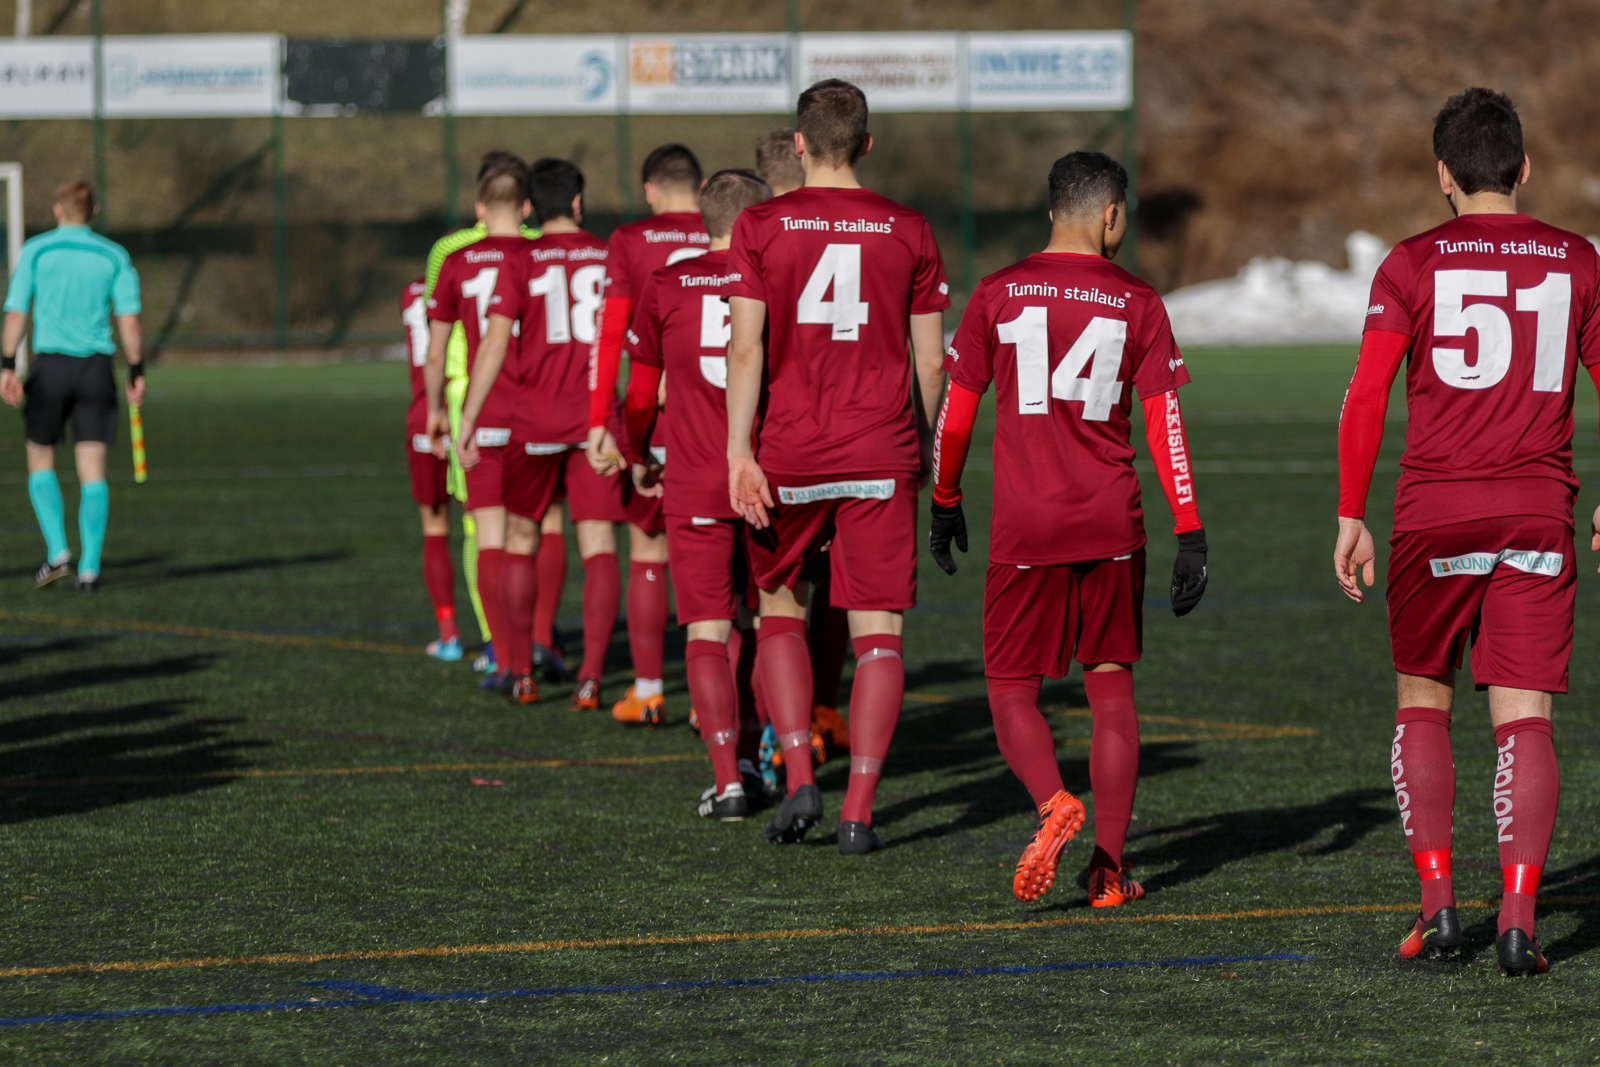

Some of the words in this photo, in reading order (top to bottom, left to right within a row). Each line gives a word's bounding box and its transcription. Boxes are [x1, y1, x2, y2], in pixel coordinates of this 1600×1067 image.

[780, 216, 830, 231] Tunnin
[834, 218, 892, 234] stailaus
[643, 229, 687, 243] Tunnin
[464, 248, 505, 264] Tunnin
[530, 246, 567, 263] Tunnin
[1436, 238, 1495, 255] Tunnin
[1500, 240, 1567, 259] stailaus
[678, 273, 724, 287] Tunnin
[797, 243, 869, 341] 4
[1005, 281, 1058, 298] Tunnin
[1063, 282, 1127, 309] stailaus
[528, 264, 606, 344] 18
[1432, 269, 1571, 393] 51
[996, 305, 1128, 422] 14
